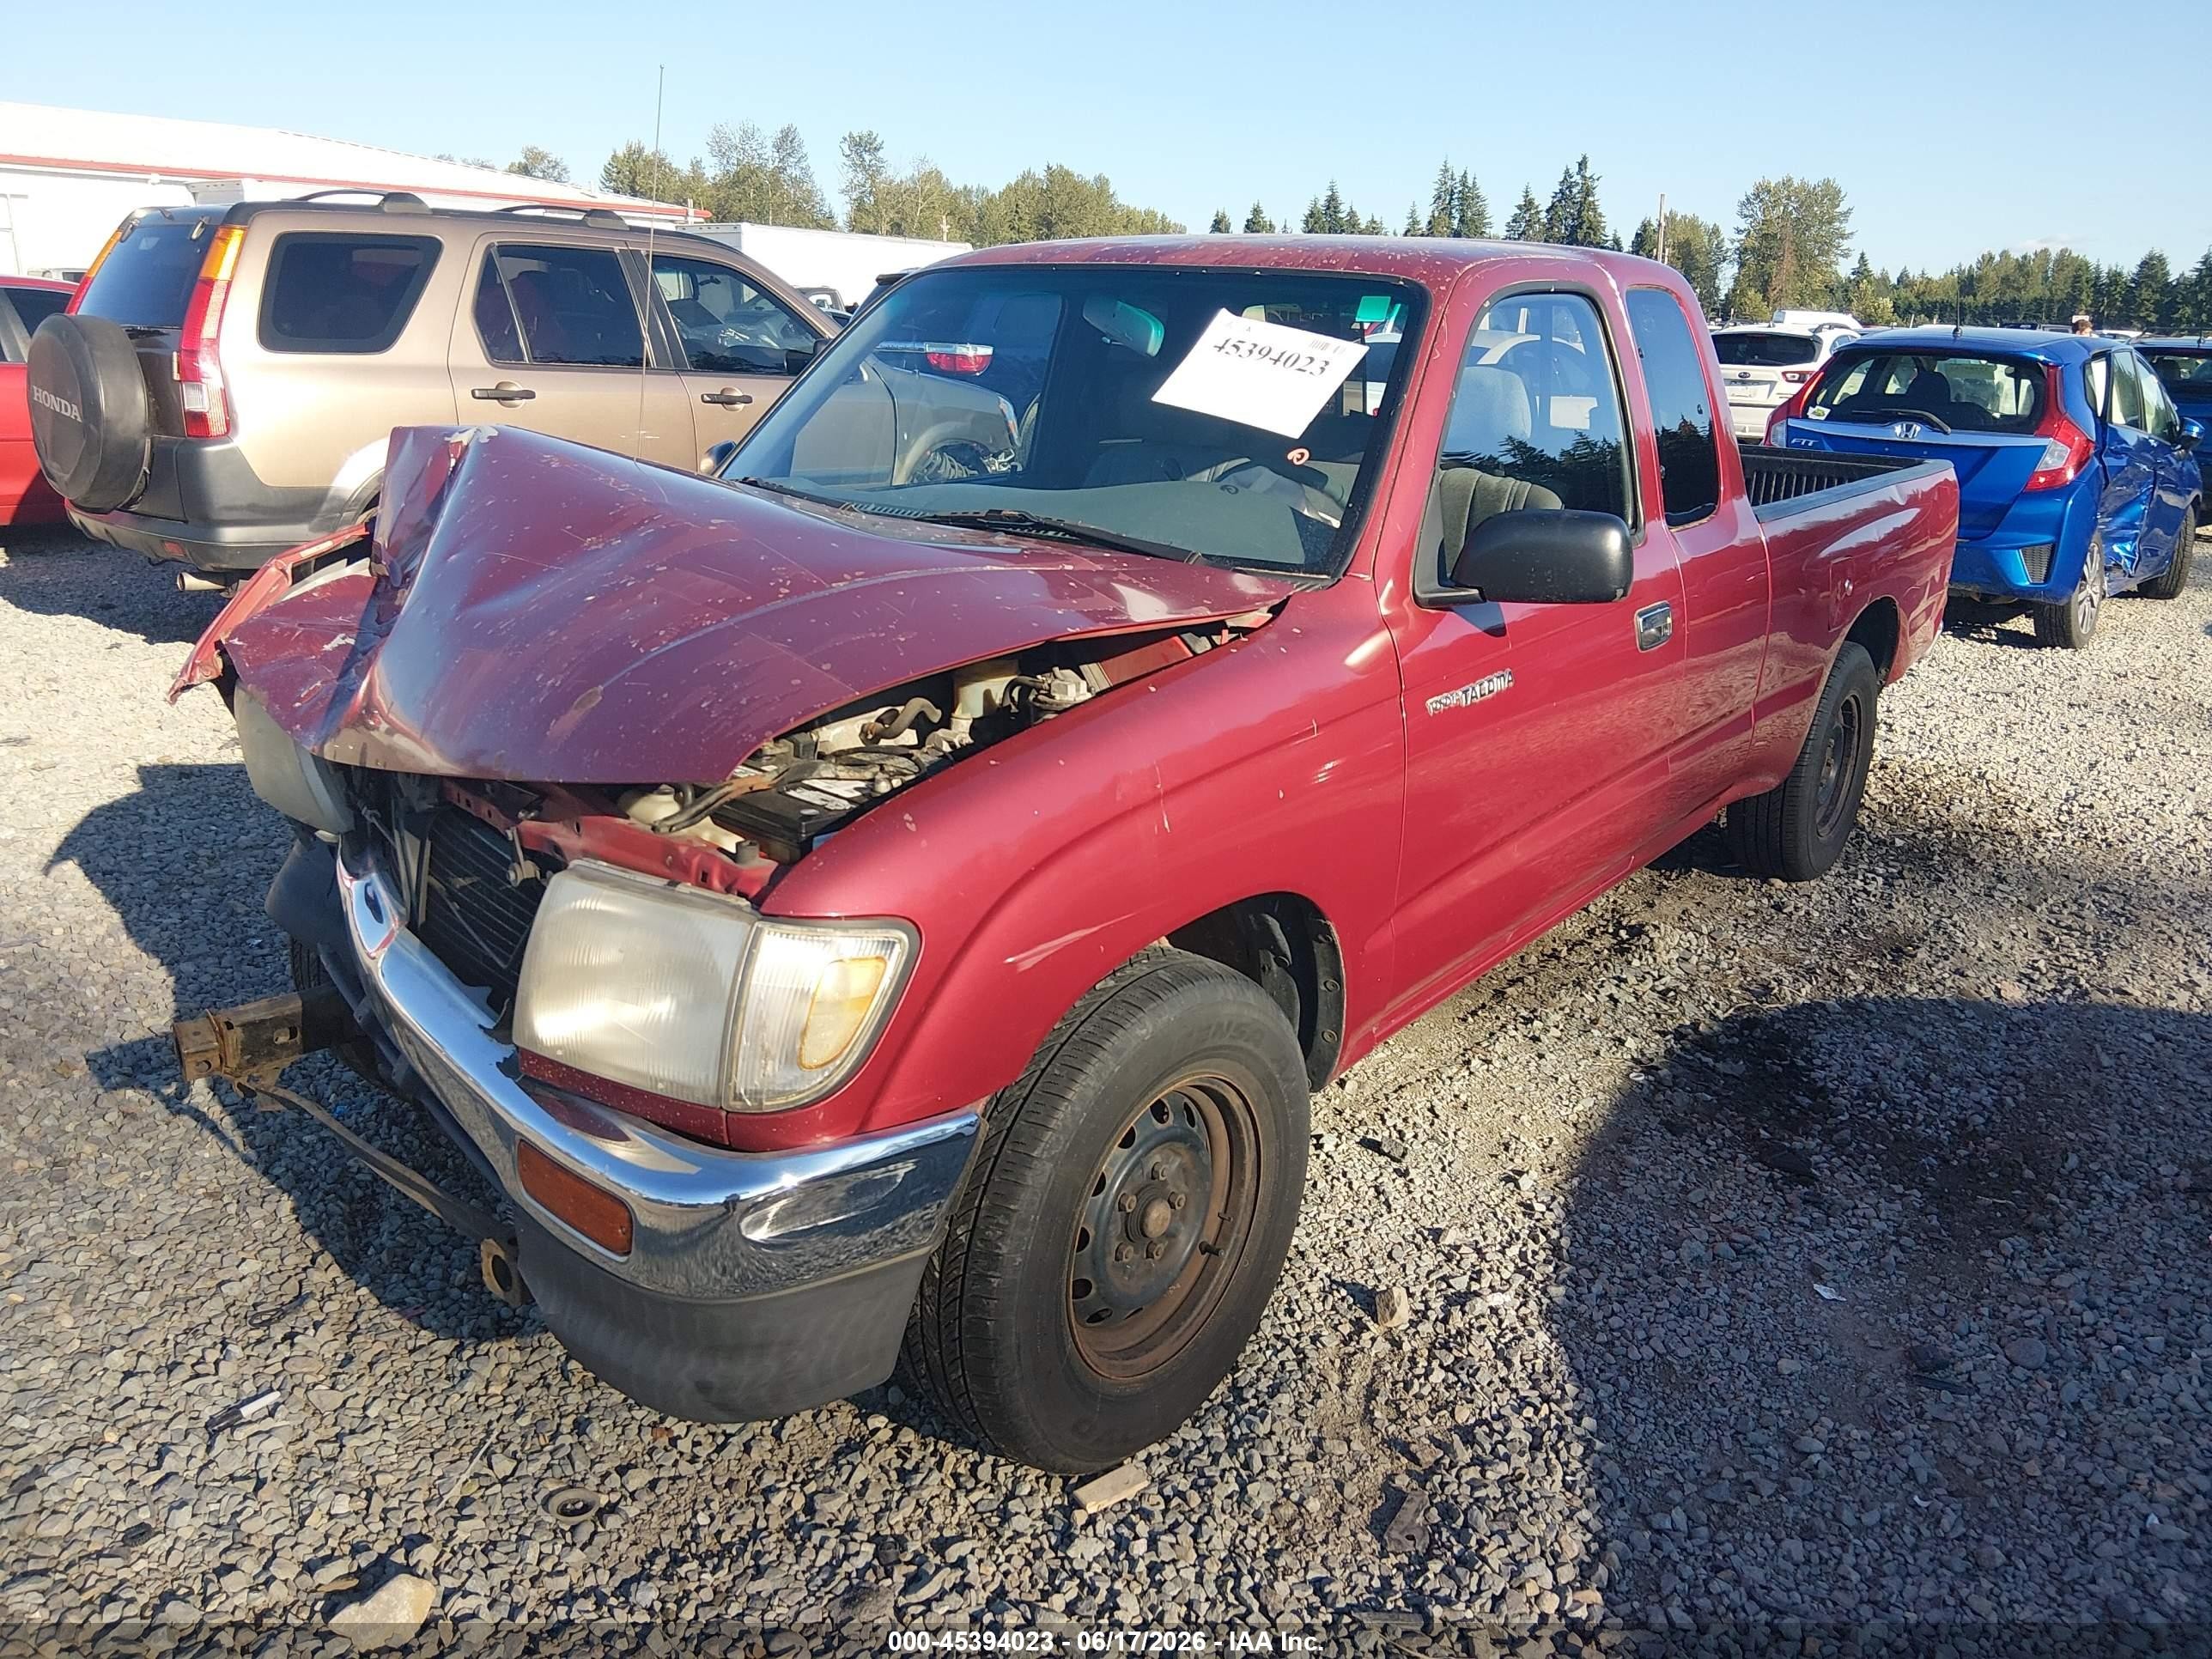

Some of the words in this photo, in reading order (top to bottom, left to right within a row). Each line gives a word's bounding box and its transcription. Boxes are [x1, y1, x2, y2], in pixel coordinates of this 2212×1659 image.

[1213, 337, 1330, 377] 45394023
[33, 385, 82, 423] HONDA
[1461, 668, 1514, 707] TACOMA
